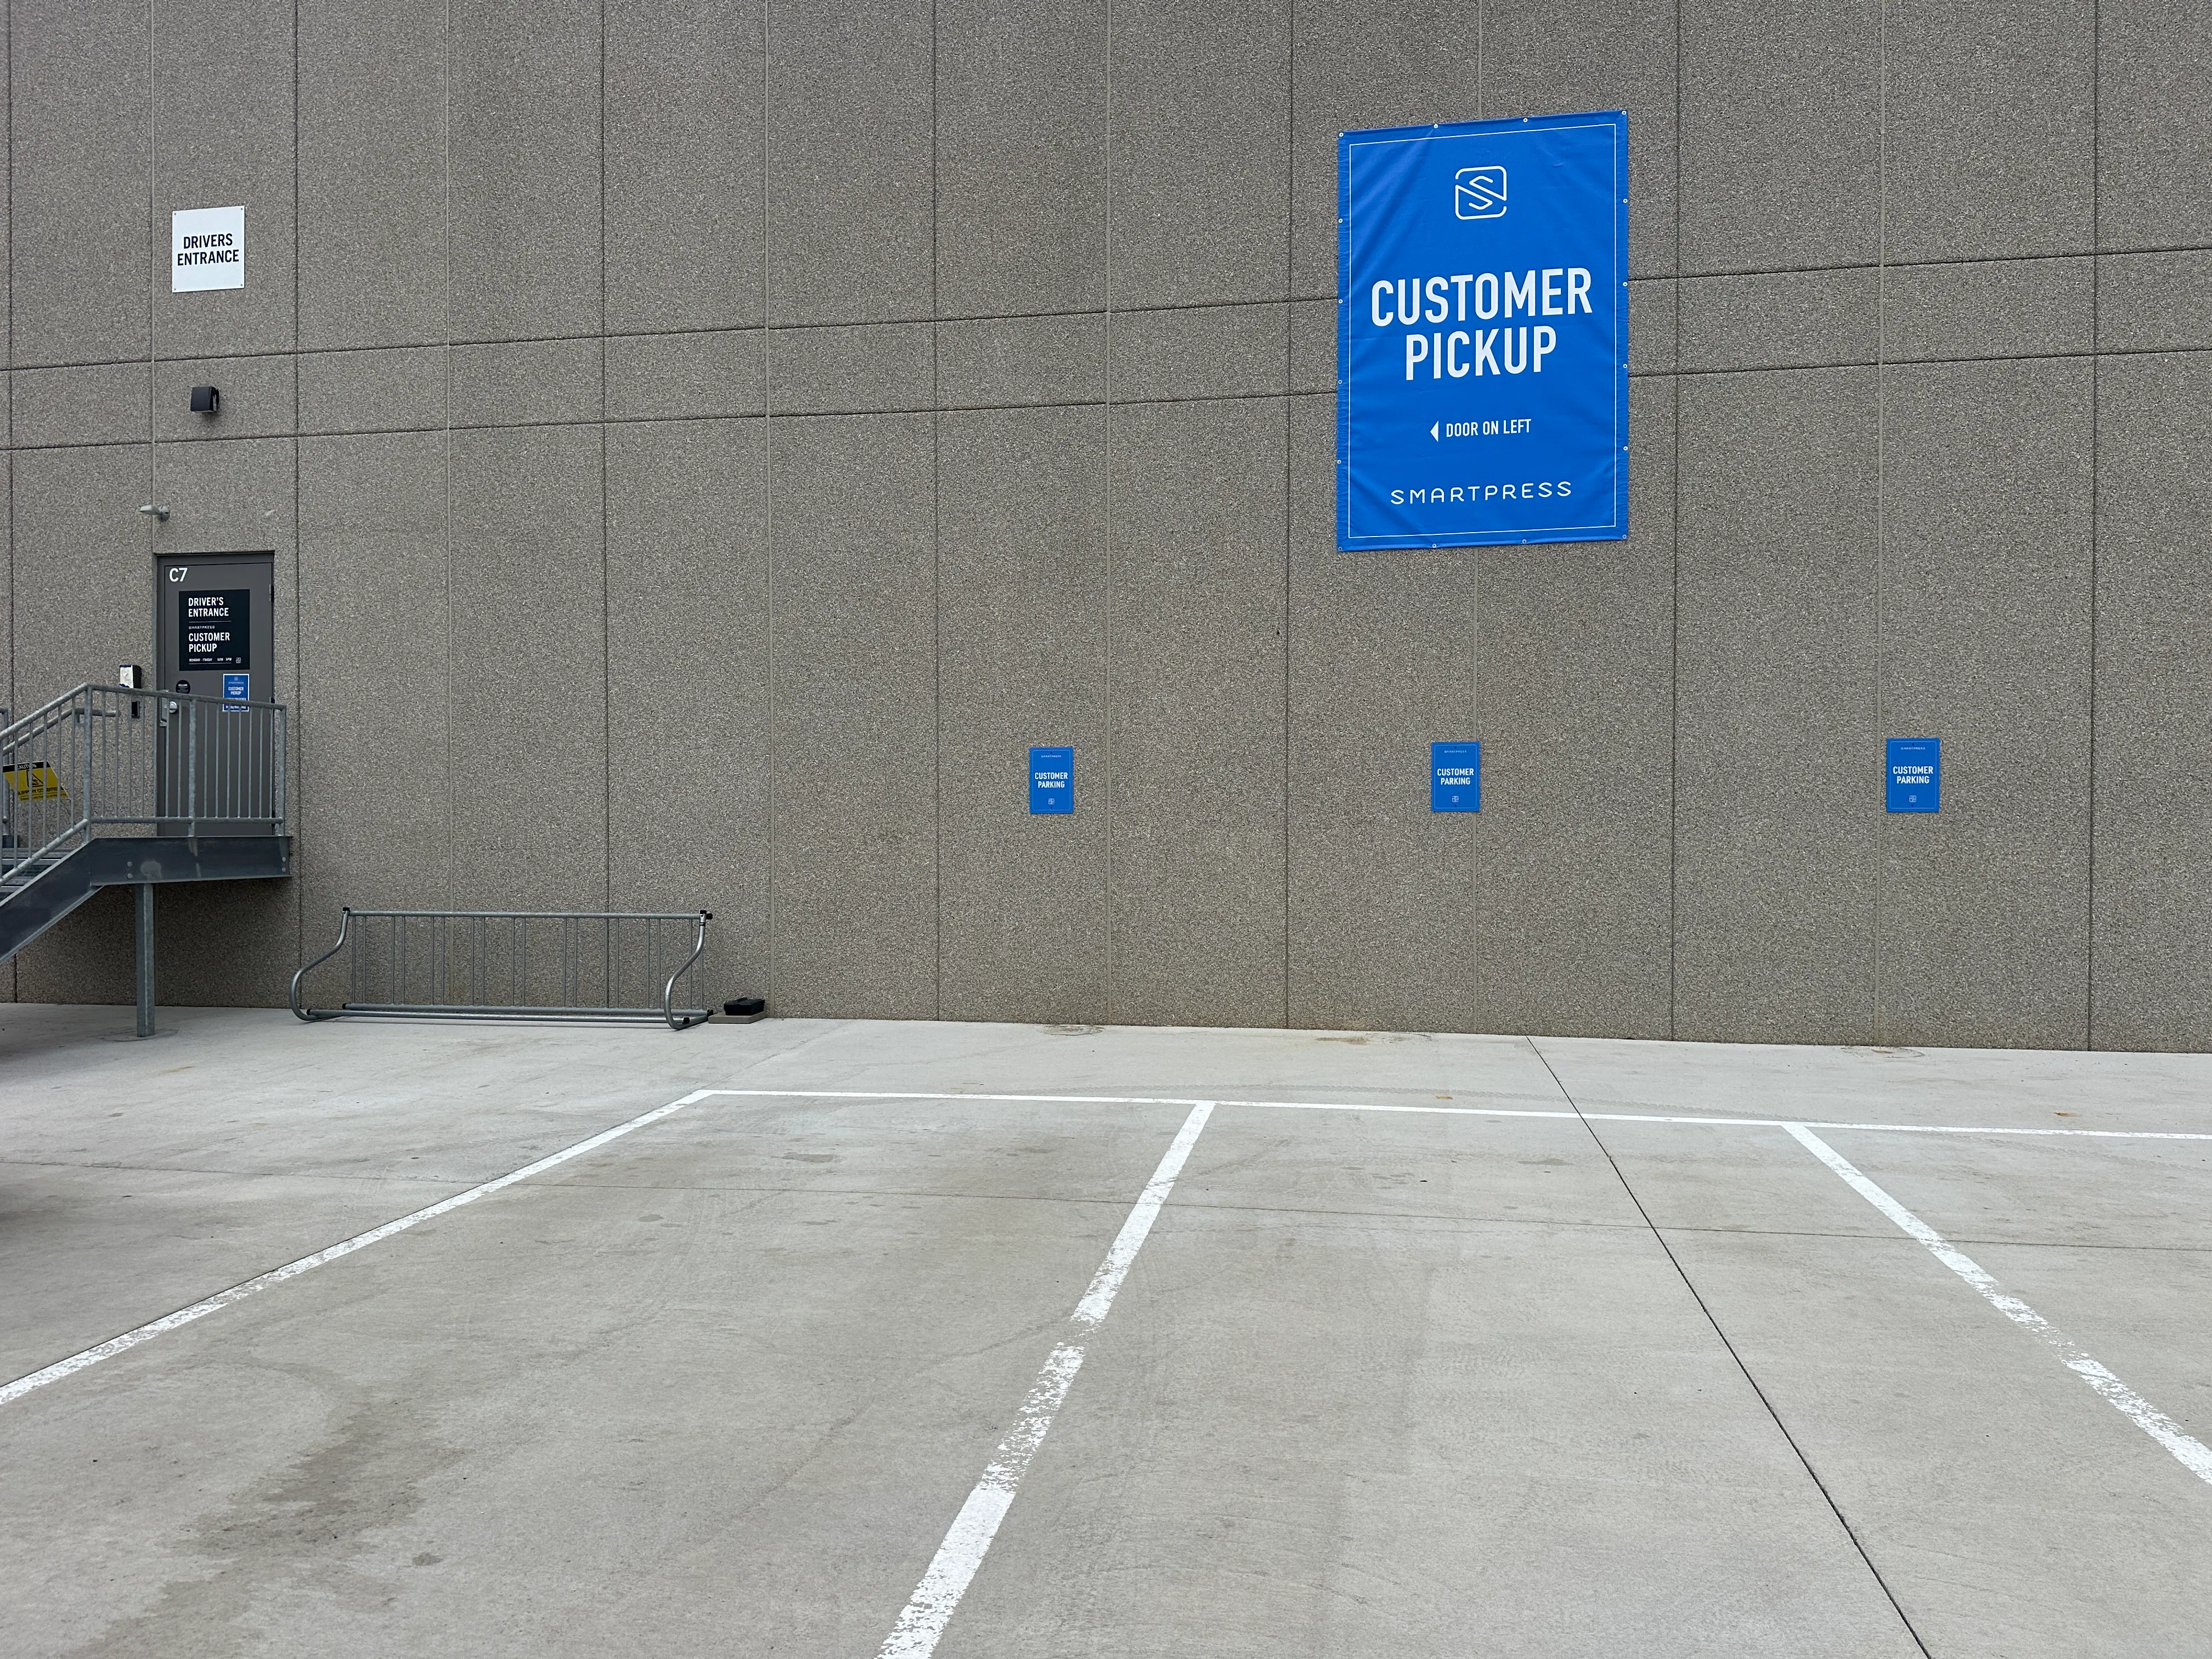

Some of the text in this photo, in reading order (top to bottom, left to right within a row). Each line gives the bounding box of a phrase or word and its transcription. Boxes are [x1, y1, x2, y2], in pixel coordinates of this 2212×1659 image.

[183, 233, 233, 249] DRIVERS
[177, 249, 239, 266] ENTRANCE
[1372, 267, 1593, 327] CUSTOMER
[1406, 325, 1557, 381] PICKUP
[1446, 419, 1532, 437] DOOR ON LEFT
[1390, 481, 1571, 505] SMARTPRESS
[169, 567, 188, 582] C7
[188, 597, 224, 606] DRIVER'S
[188, 607, 229, 617] ENTRANCE
[189, 632, 230, 642] CUSTOMER
[189, 643, 217, 653] PICKUP
[1437, 768, 1474, 776] CUSTOMER
[1893, 766, 1933, 775] CUSTOMER
[1441, 777, 1471, 785] PARKING
[1897, 775, 1929, 784] PARKING
